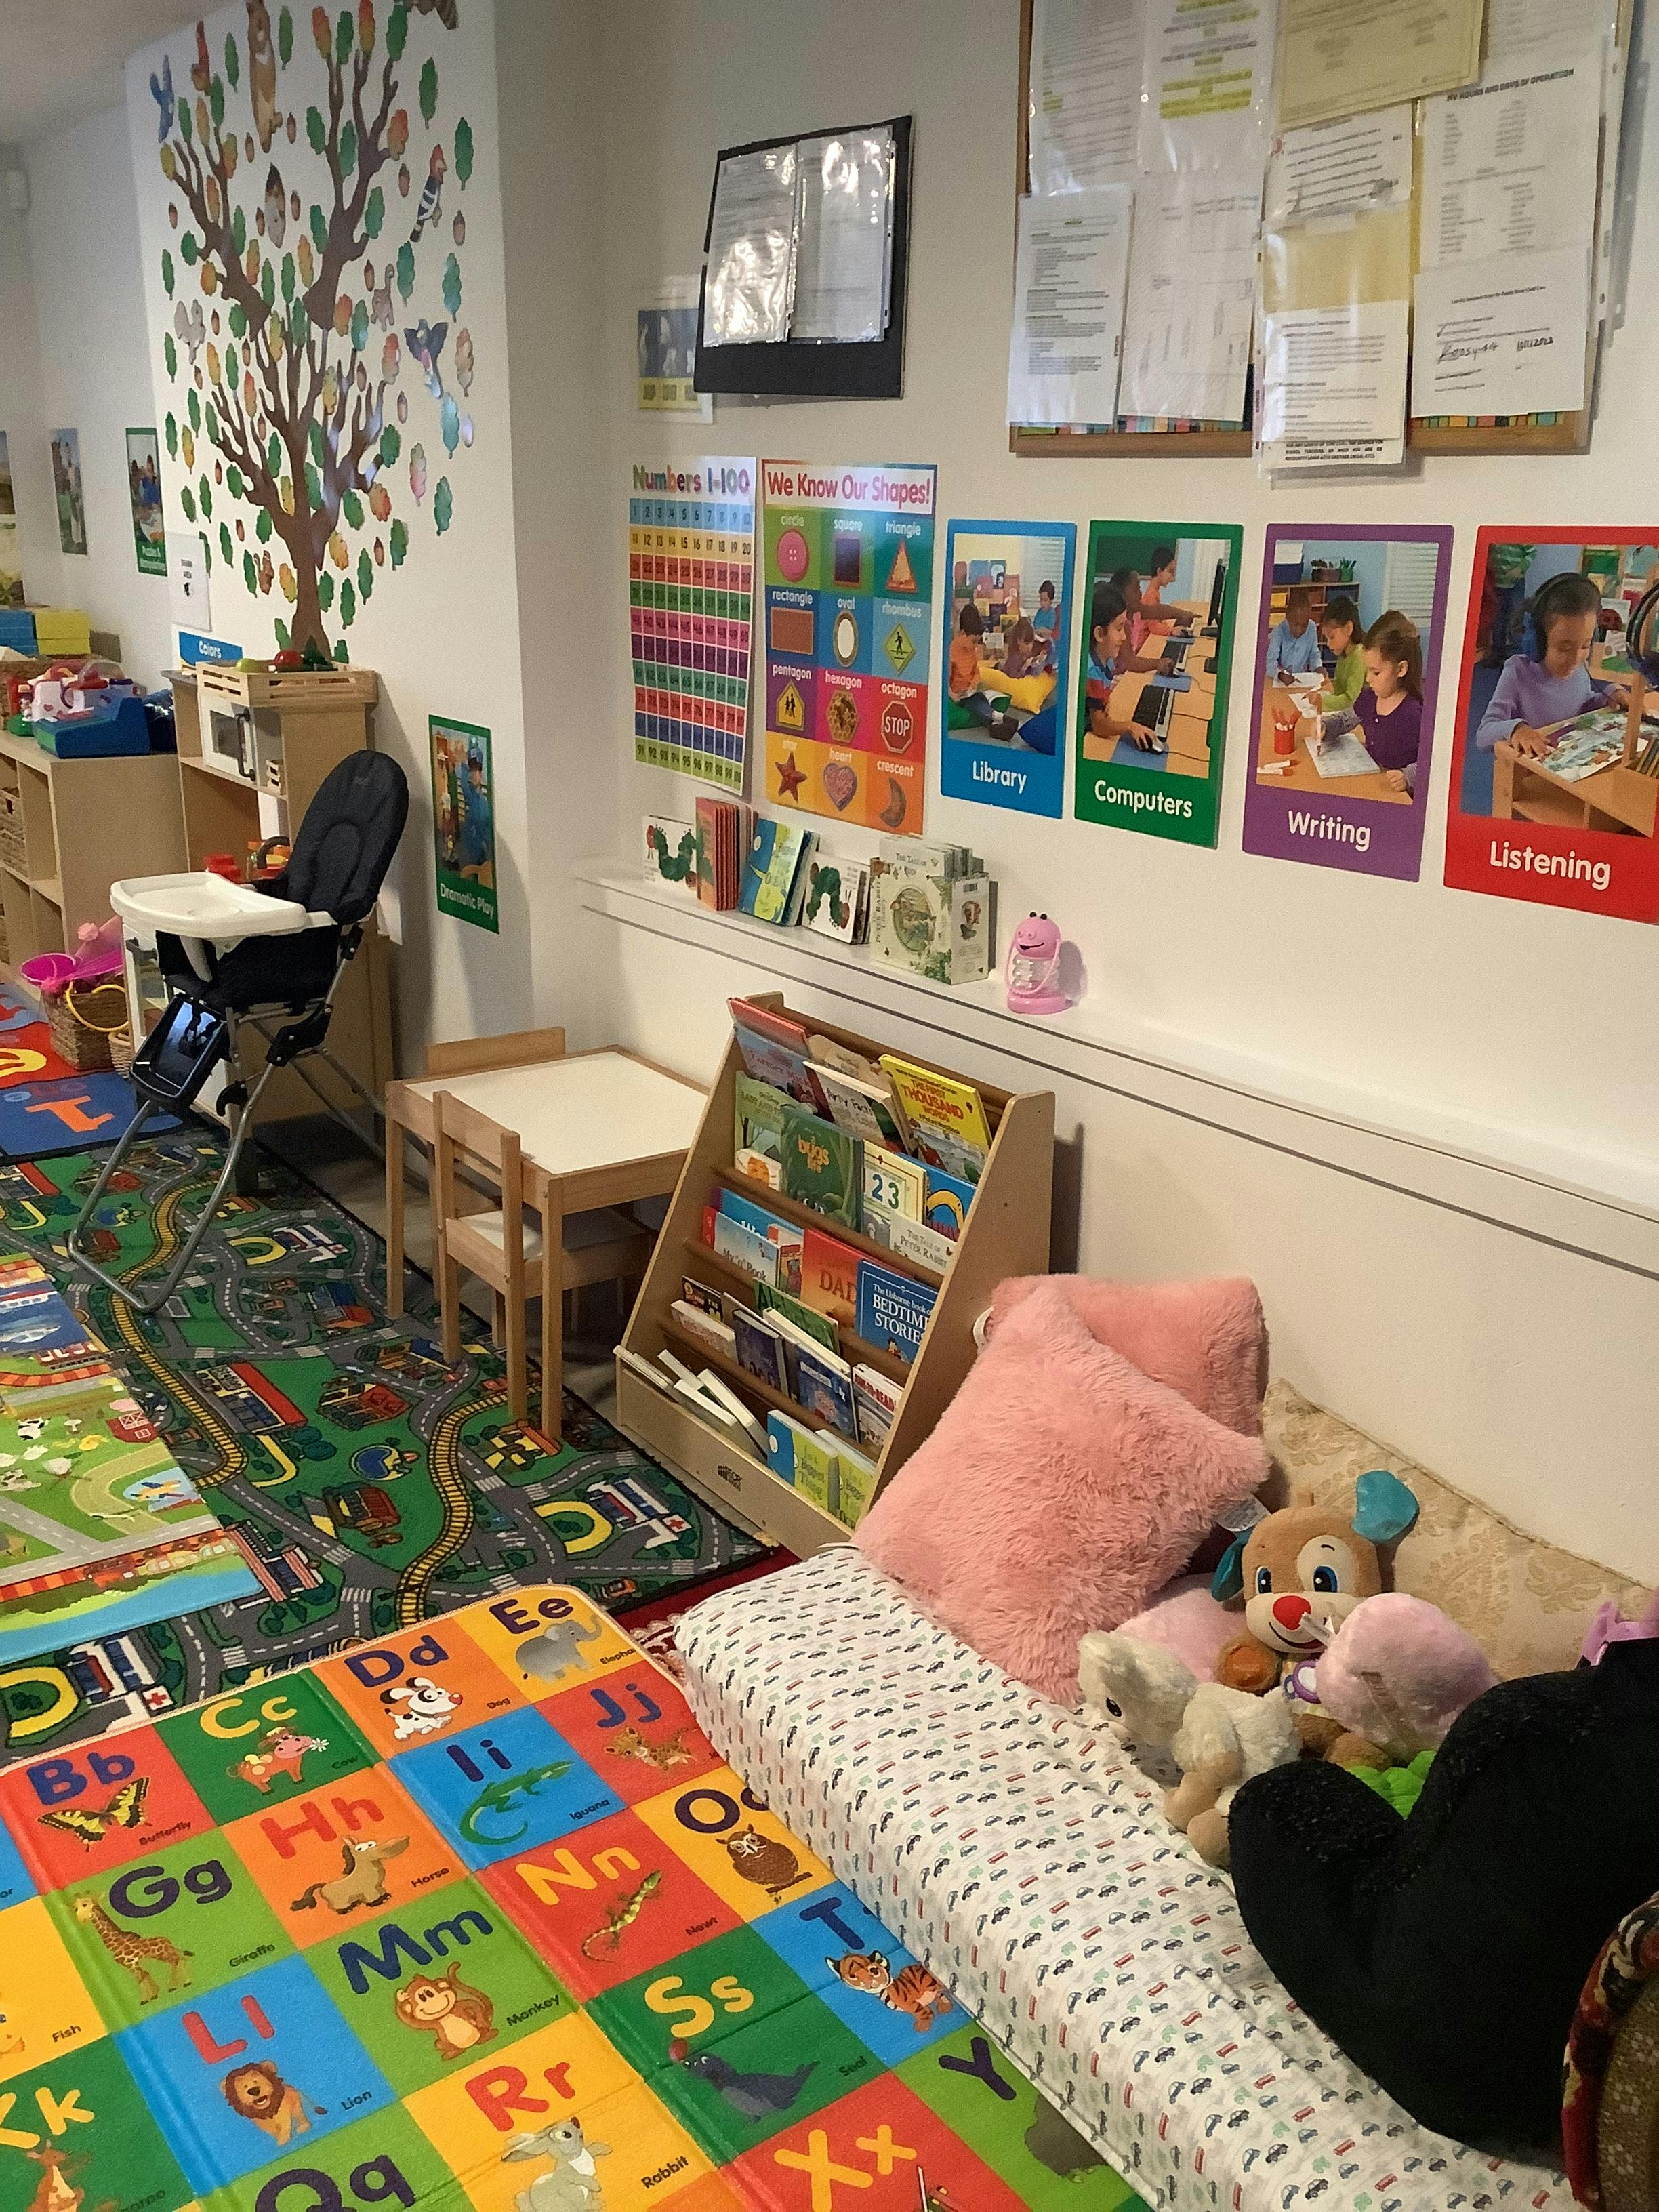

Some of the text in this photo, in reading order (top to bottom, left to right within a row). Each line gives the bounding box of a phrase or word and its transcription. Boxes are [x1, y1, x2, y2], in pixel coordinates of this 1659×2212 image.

[1459, 88, 1483, 99] HOURS
[633, 464, 751, 494] Numbers 1-100
[767, 471, 930, 510] We Know Our Shapes!
[645, 506, 650, 518] 2
[657, 507, 662, 518] 3
[669, 508, 674, 518] 4
[682, 508, 687, 520] 5
[694, 510, 699, 521] 6
[707, 510, 712, 522] 7
[781, 514, 805, 527] circle
[834, 518, 863, 532] square
[886, 520, 922, 538] triangle
[632, 533, 751, 555] 11 12 13 14 15 16 17 18 19 20
[772, 590, 813, 606] rectangle
[837, 596, 855, 610] oval
[882, 600, 922, 618] rhombus
[199, 640, 222, 659] Colors
[772, 663, 812, 680] pentagon
[825, 670, 863, 690] hexagon
[881, 682, 918, 700] octagon
[884, 715, 911, 737] STOP
[648, 746, 657, 758] 92
[660, 750, 669, 761] 93
[671, 753, 680, 764] 94
[682, 755, 691, 767] 95
[693, 758, 701, 770] 96
[704, 761, 713, 772] 97
[715, 764, 722, 776] 98
[725, 767, 733, 779] 99
[829, 747, 853, 763] heart
[876, 759, 914, 777] crescent
[972, 760, 1027, 794] Library
[1094, 779, 1193, 818] Computers
[1288, 810, 1371, 852] Writing
[1490, 840, 1611, 890] Listening
[440, 882, 494, 920] Dramatic Play
[900, 1084, 964, 1120] THOUSAND
[798, 1133, 830, 1166] bug's
[888, 1181, 899, 1209] 3
[900, 1235, 947, 1268] PETER RABBIT
[873, 1283, 926, 1313] The Usborne book
[489, 1597, 574, 1635] Ee
[344, 1635, 449, 1688] Dd
[200, 1695, 298, 1739] Cc
[487, 1697, 512, 1711] Dog
[590, 1683, 663, 1729] Jj
[331, 1754, 359, 1771] Cow
[446, 1738, 512, 1782] Ii
[26, 1751, 136, 1807] Bb
[569, 1798, 611, 1820] Iguana
[138, 1818, 191, 1846] Butterfly
[260, 1796, 385, 1860] Hh
[108, 1858, 233, 1919] Gg
[411, 1866, 450, 1889] Horse
[515, 1846, 641, 1906] Nn
[685, 1916, 719, 1937] Newt
[228, 1942, 276, 1969] Giraffe
[337, 1909, 494, 1995] Mm
[506, 1992, 562, 2028] Monkey
[644, 1974, 755, 2038] Ss
[52, 2023, 82, 2043] Fish
[838, 2055, 869, 2078] Seal
[341, 2089, 373, 2112] Lion
[465, 2061, 576, 2132] Rr
[640, 2154, 689, 2190] Rabbit
[773, 2123, 918, 2212] Xx
[255, 2154, 417, 2212] Qq
